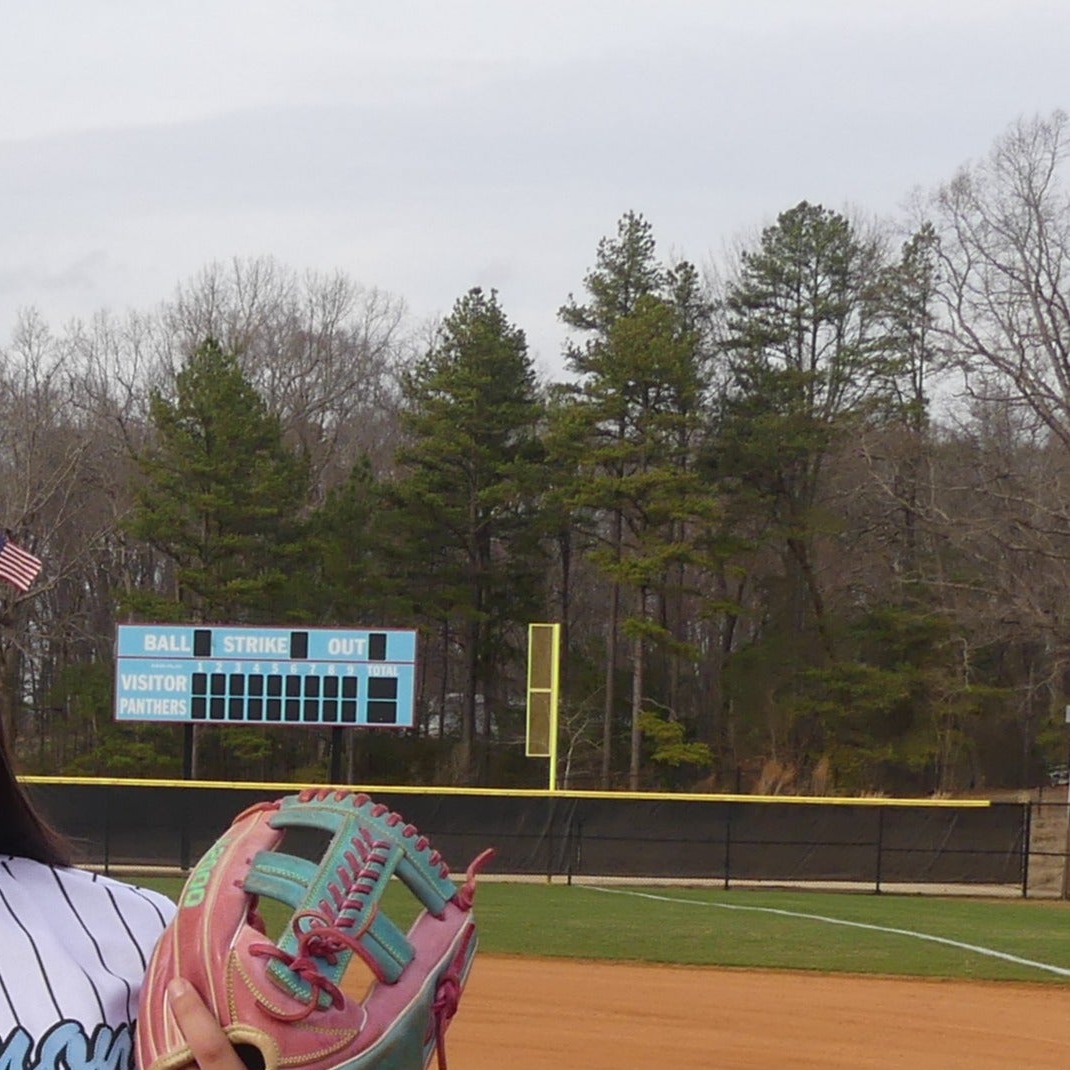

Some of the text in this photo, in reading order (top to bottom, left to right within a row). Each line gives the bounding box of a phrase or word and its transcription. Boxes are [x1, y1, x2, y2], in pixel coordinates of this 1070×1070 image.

[144, 634, 367, 656] BALL STRIKE OUT
[215, 663, 223, 673] 2
[235, 663, 241, 673] 3
[252, 663, 260, 674] 4
[272, 664, 279, 674] 5
[290, 664, 298, 674] 6
[309, 665, 316, 675] 7
[327, 665, 335, 675] 8
[347, 665, 354, 675] 9
[367, 665, 399, 677] TOTAL
[120, 674, 188, 692] VISITOR
[119, 698, 187, 715] PANTHERS
